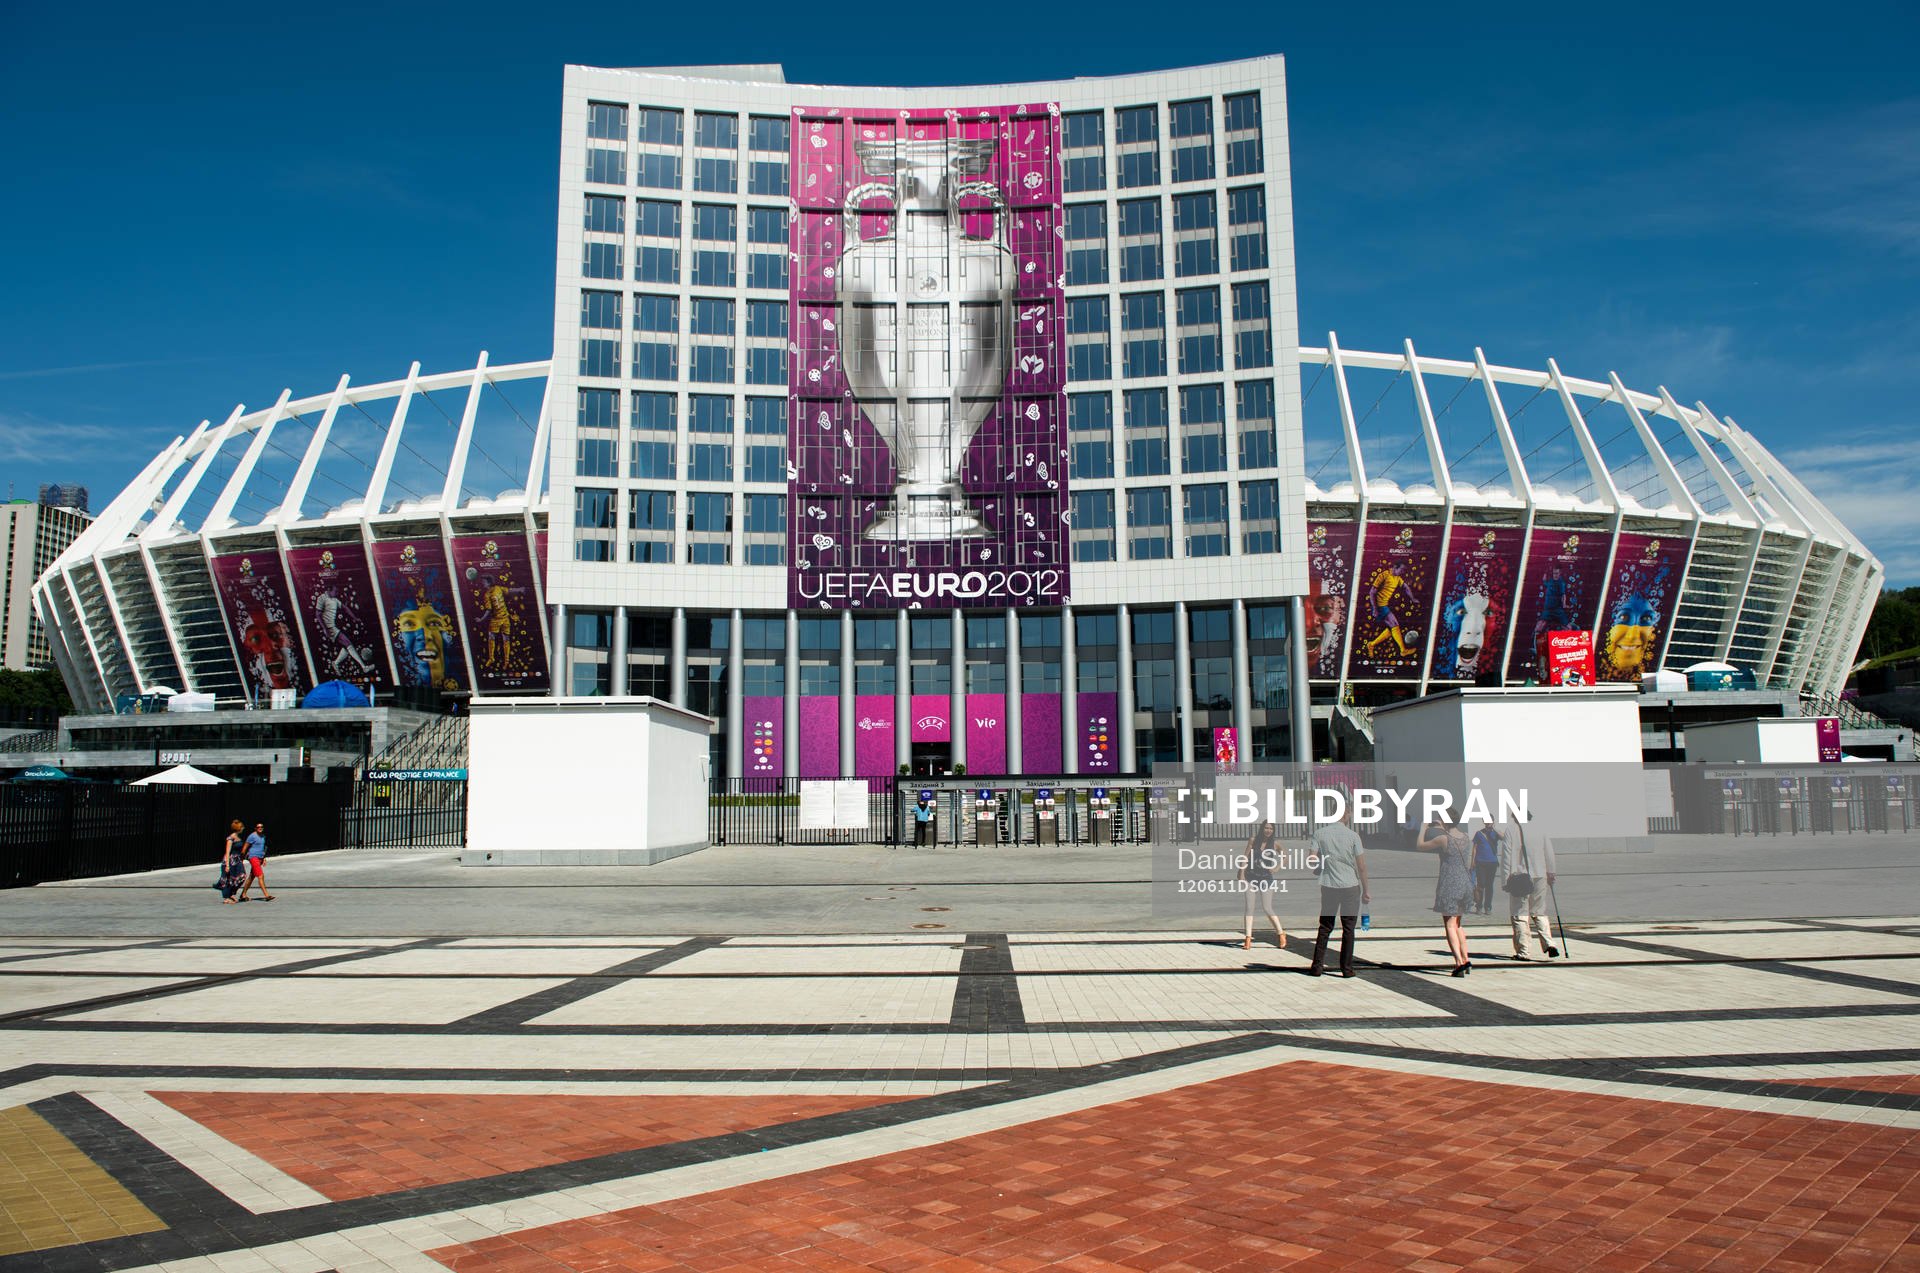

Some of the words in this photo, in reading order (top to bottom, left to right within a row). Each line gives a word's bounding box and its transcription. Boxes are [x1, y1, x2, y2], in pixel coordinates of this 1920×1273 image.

[918, 718, 944, 728] UEFA
[161, 752, 191, 763] SPORT
[369, 771, 388, 779] CLUB
[389, 771, 422, 780] PRESTIGE
